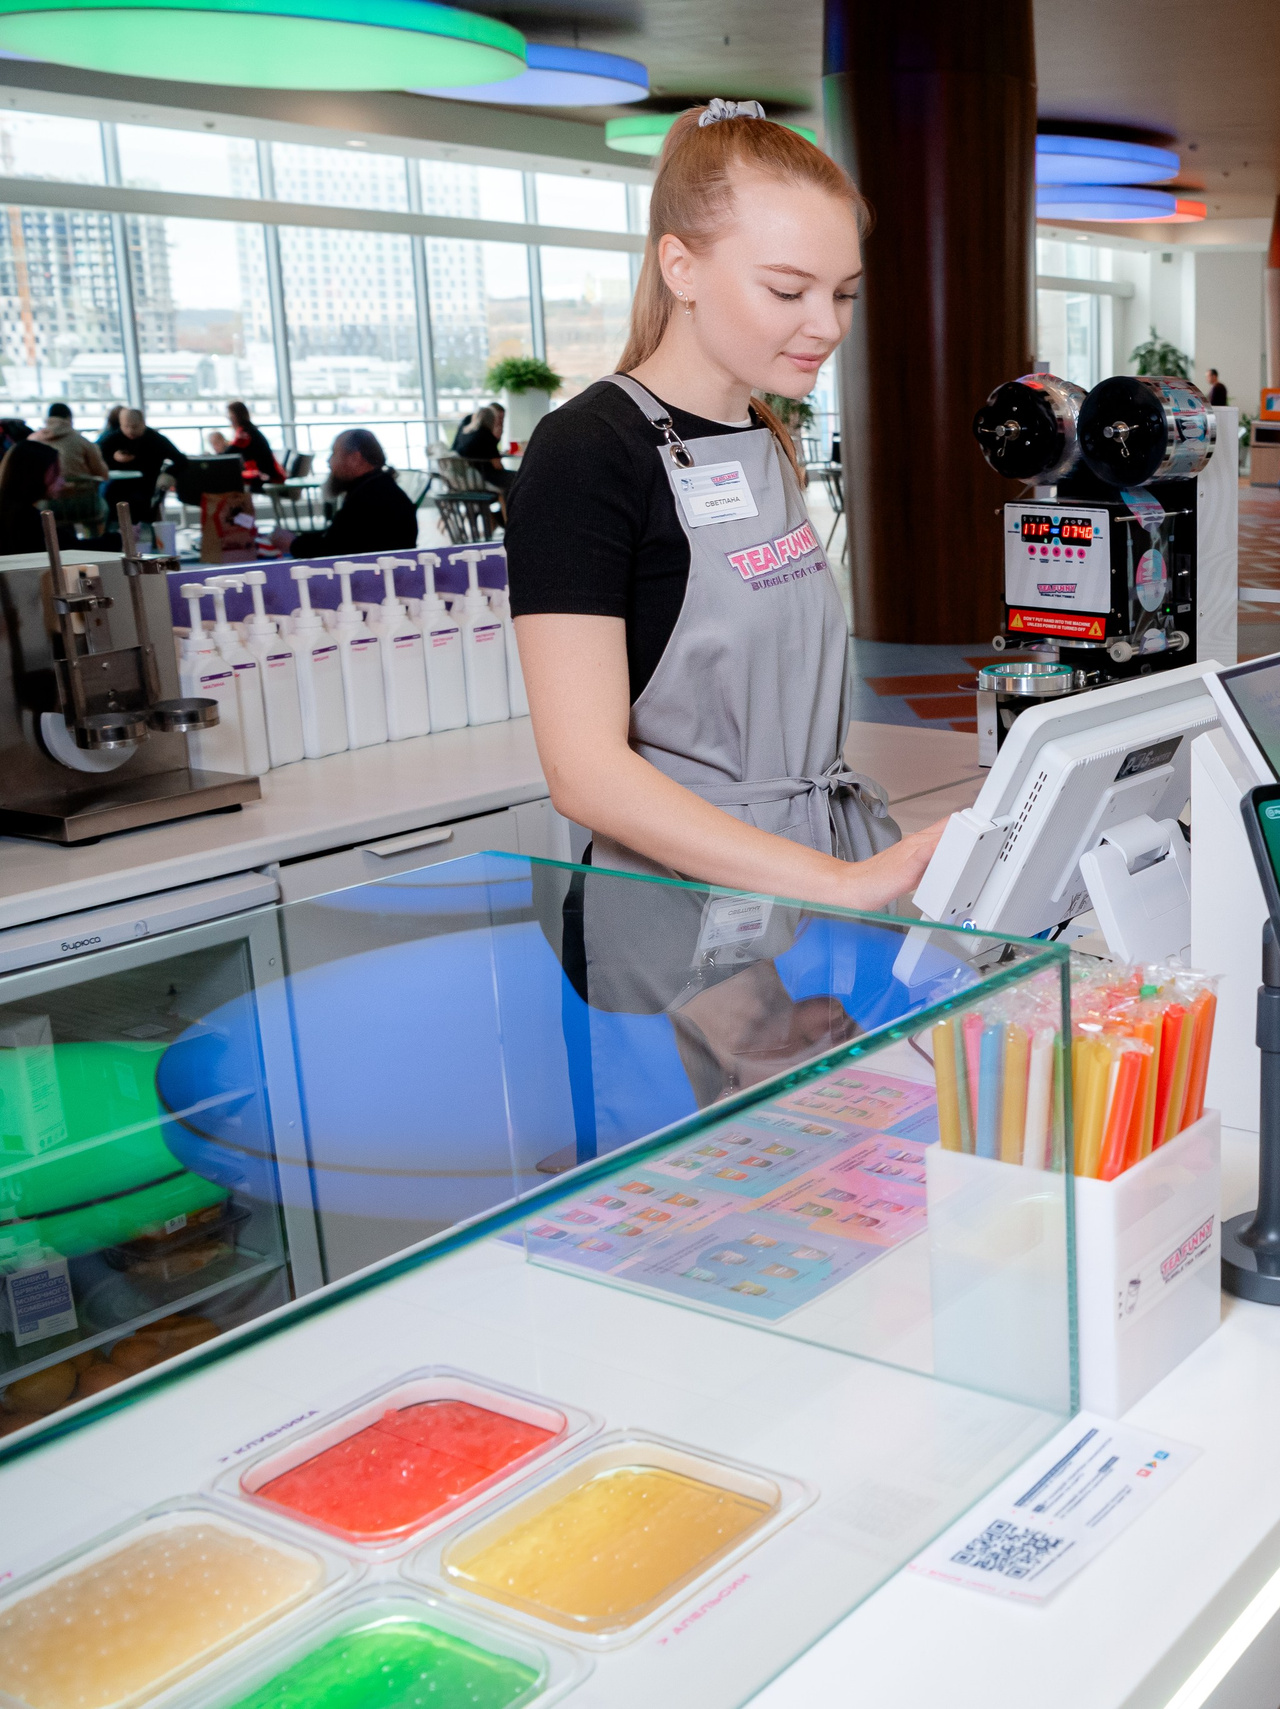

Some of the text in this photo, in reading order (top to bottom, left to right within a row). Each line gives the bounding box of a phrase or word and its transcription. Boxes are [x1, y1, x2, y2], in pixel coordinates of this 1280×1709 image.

[705, 496, 741, 508] СВЕТЛАНА
[730, 544, 779, 578] TEA
[61, 936, 101, 952] бирюса
[1162, 1252, 1181, 1276] TEA
[1181, 1220, 1213, 1258] FUNNY
[12, 1272, 49, 1288] СЛИВКИ
[14, 1277, 65, 1297] БРЯНСКОГО
[16, 1285, 69, 1306] МОЛОЧНОГО
[17, 1295, 69, 1314] КОМБИНАТА
[233, 1410, 319, 1454] КЛУБНИКА
